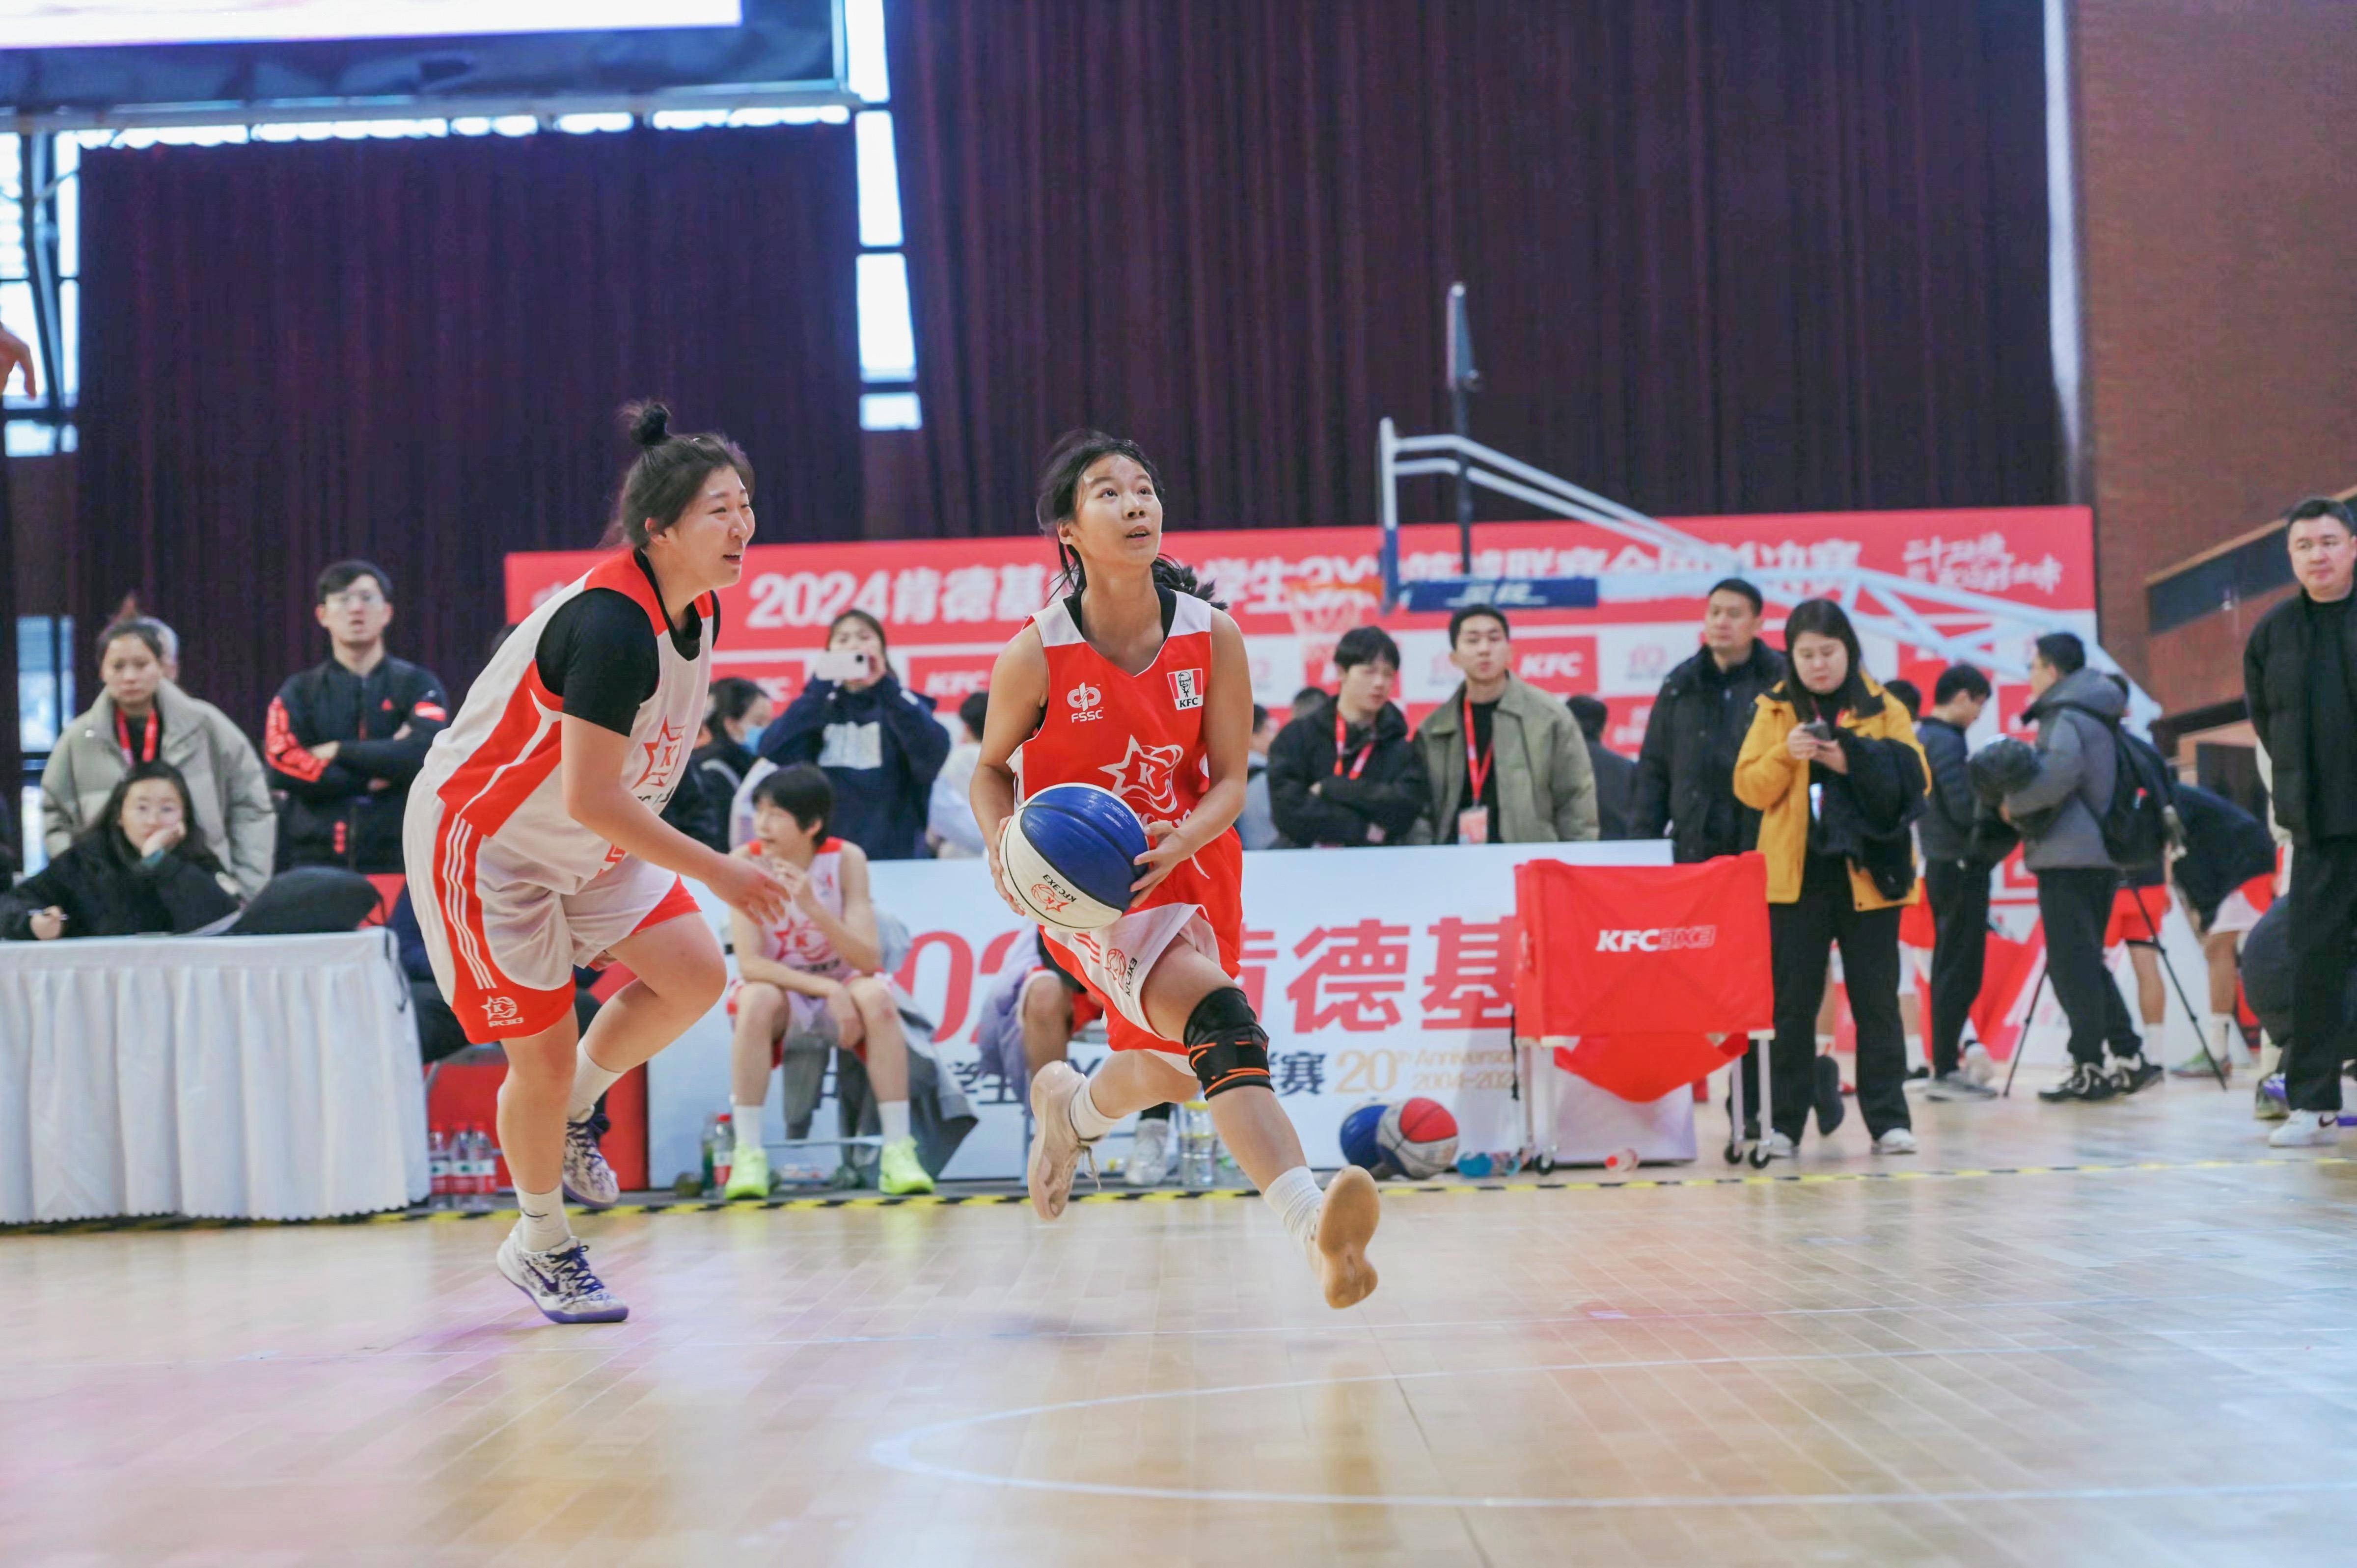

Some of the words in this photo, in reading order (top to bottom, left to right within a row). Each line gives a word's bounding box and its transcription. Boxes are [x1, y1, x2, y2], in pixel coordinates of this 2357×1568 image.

[1518, 653, 1584, 679] KFC
[1179, 697, 1199, 708] KFC
[1071, 709, 1104, 723] FSSC
[1138, 762, 1155, 789] K
